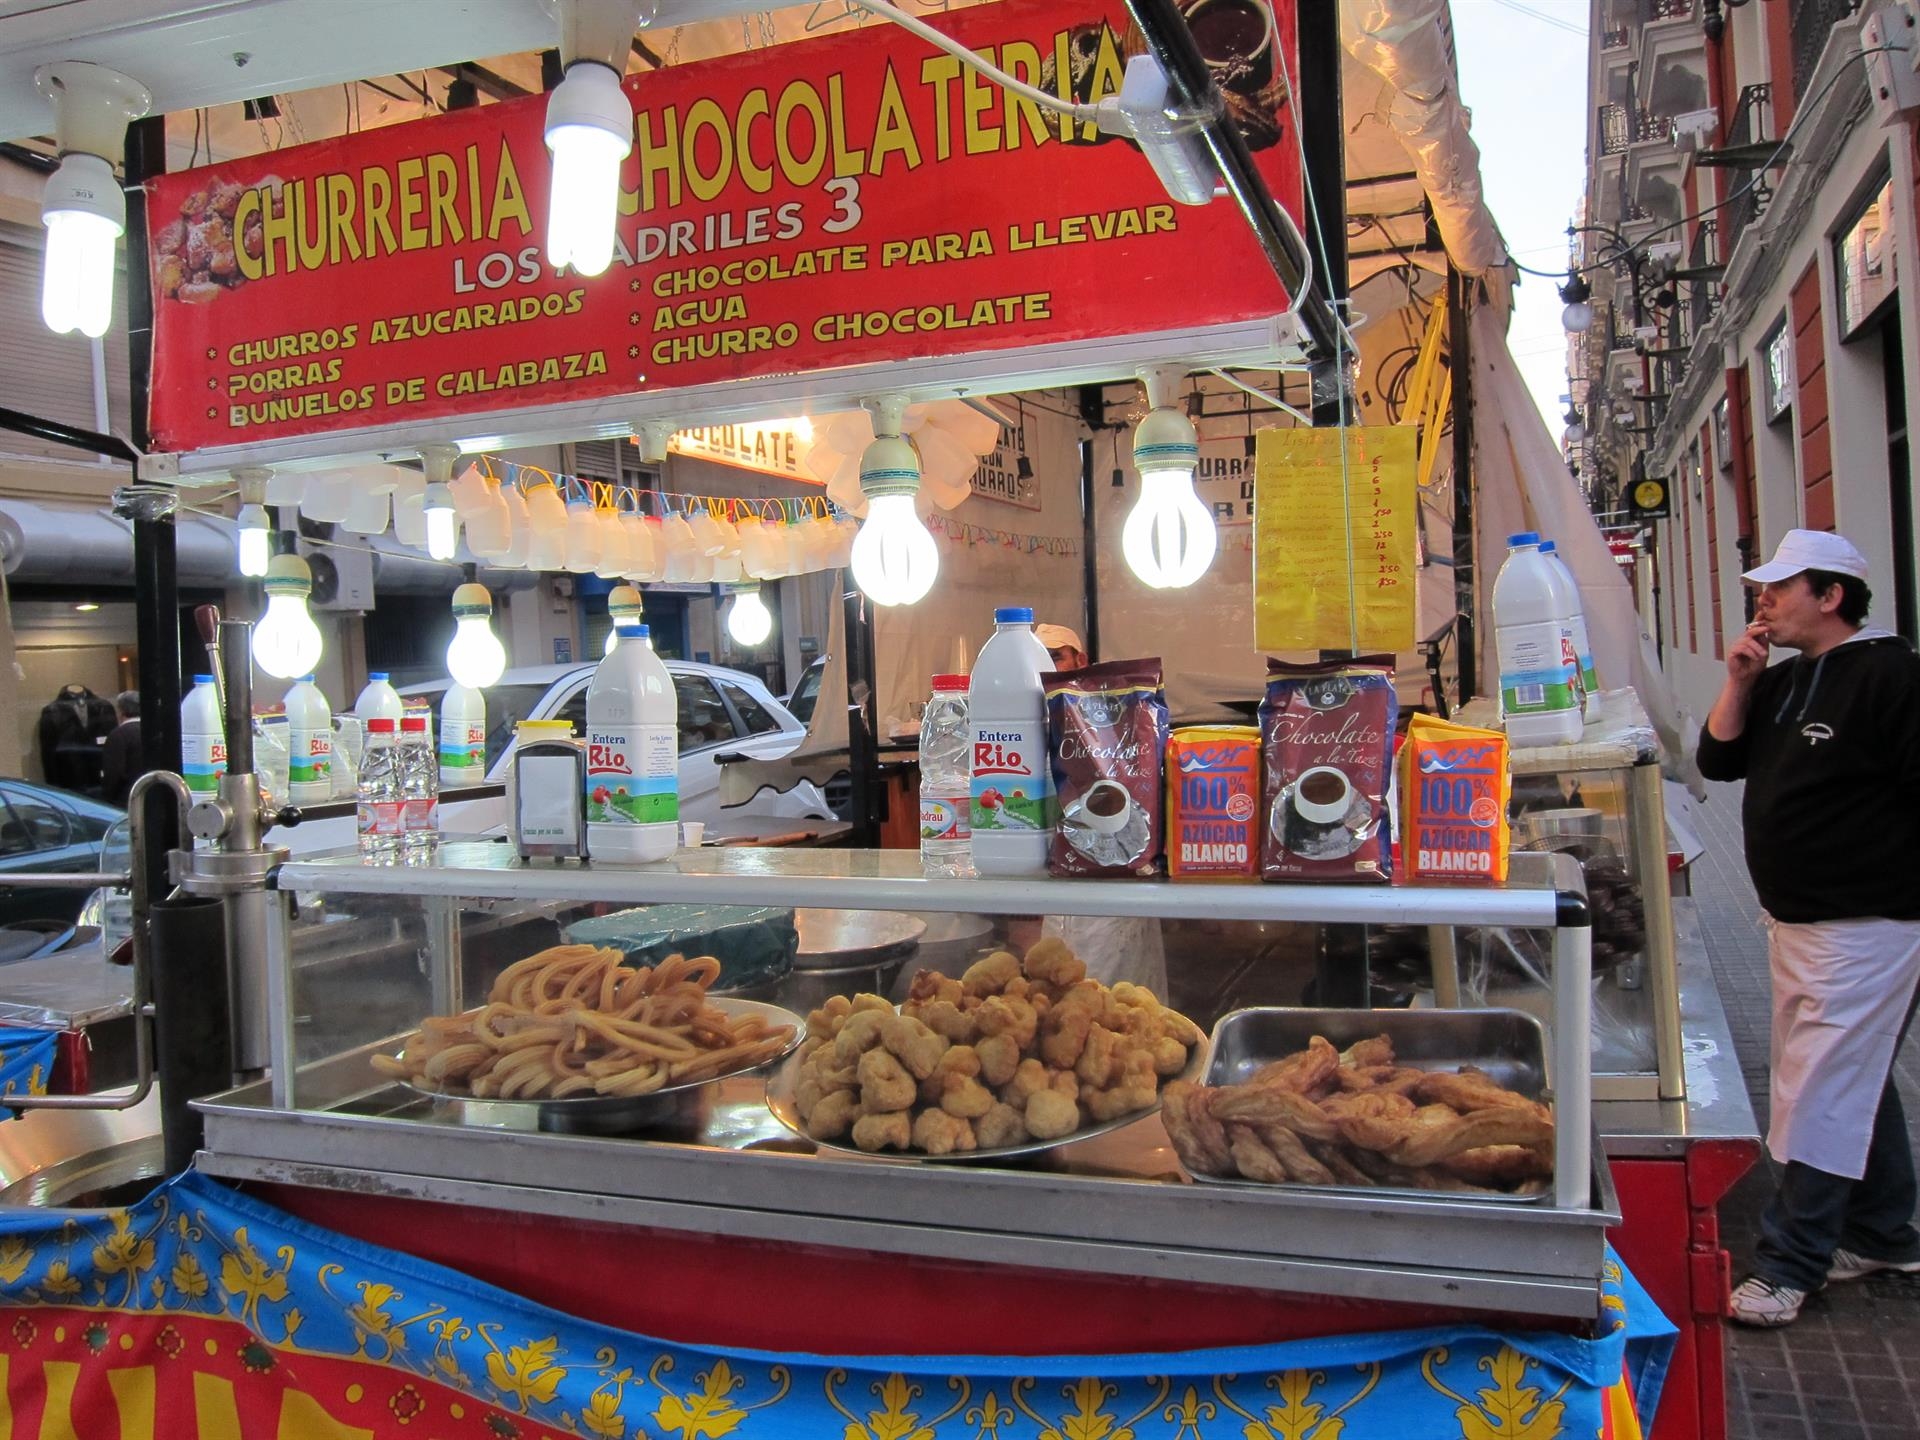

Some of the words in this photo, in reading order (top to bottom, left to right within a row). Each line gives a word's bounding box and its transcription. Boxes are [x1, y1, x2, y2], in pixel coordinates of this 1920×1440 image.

[233, 133, 532, 282] CHURRERIA
[453, 247, 541, 294] LOS
[556, 202, 804, 278] ADRILES
[820, 175, 863, 234] 3
[651, 245, 868, 298] CHOCOLATE
[882, 228, 993, 266] PARA
[1009, 204, 1178, 251] LLEVAR
[228, 325, 358, 367] CHURROS
[370, 289, 585, 345] AZUCARADOS
[651, 317, 798, 365] CHURRO
[814, 291, 1052, 343] CHOCOLATE
[653, 295, 747, 332] AGUA
[229, 358, 342, 397] PORRAS
[386, 378, 425, 405] DE
[437, 350, 607, 398] CALABAZA
[592, 734, 625, 744] Entera
[979, 731, 1022, 742] Entera
[1059, 724, 1152, 761] Chocolate
[1271, 711, 1380, 745] Chocolate
[211, 745, 226, 758] Ri
[589, 745, 626, 767] Rio
[974, 742, 1022, 768] Rio
[1181, 776, 1246, 810] 100%
[1420, 777, 1491, 815] 100%
[1183, 822, 1246, 843] AZÚCAR
[1420, 826, 1491, 850] AZÚCAR
[1181, 843, 1248, 863] BLANCO
[1418, 850, 1491, 872] BLANCO
